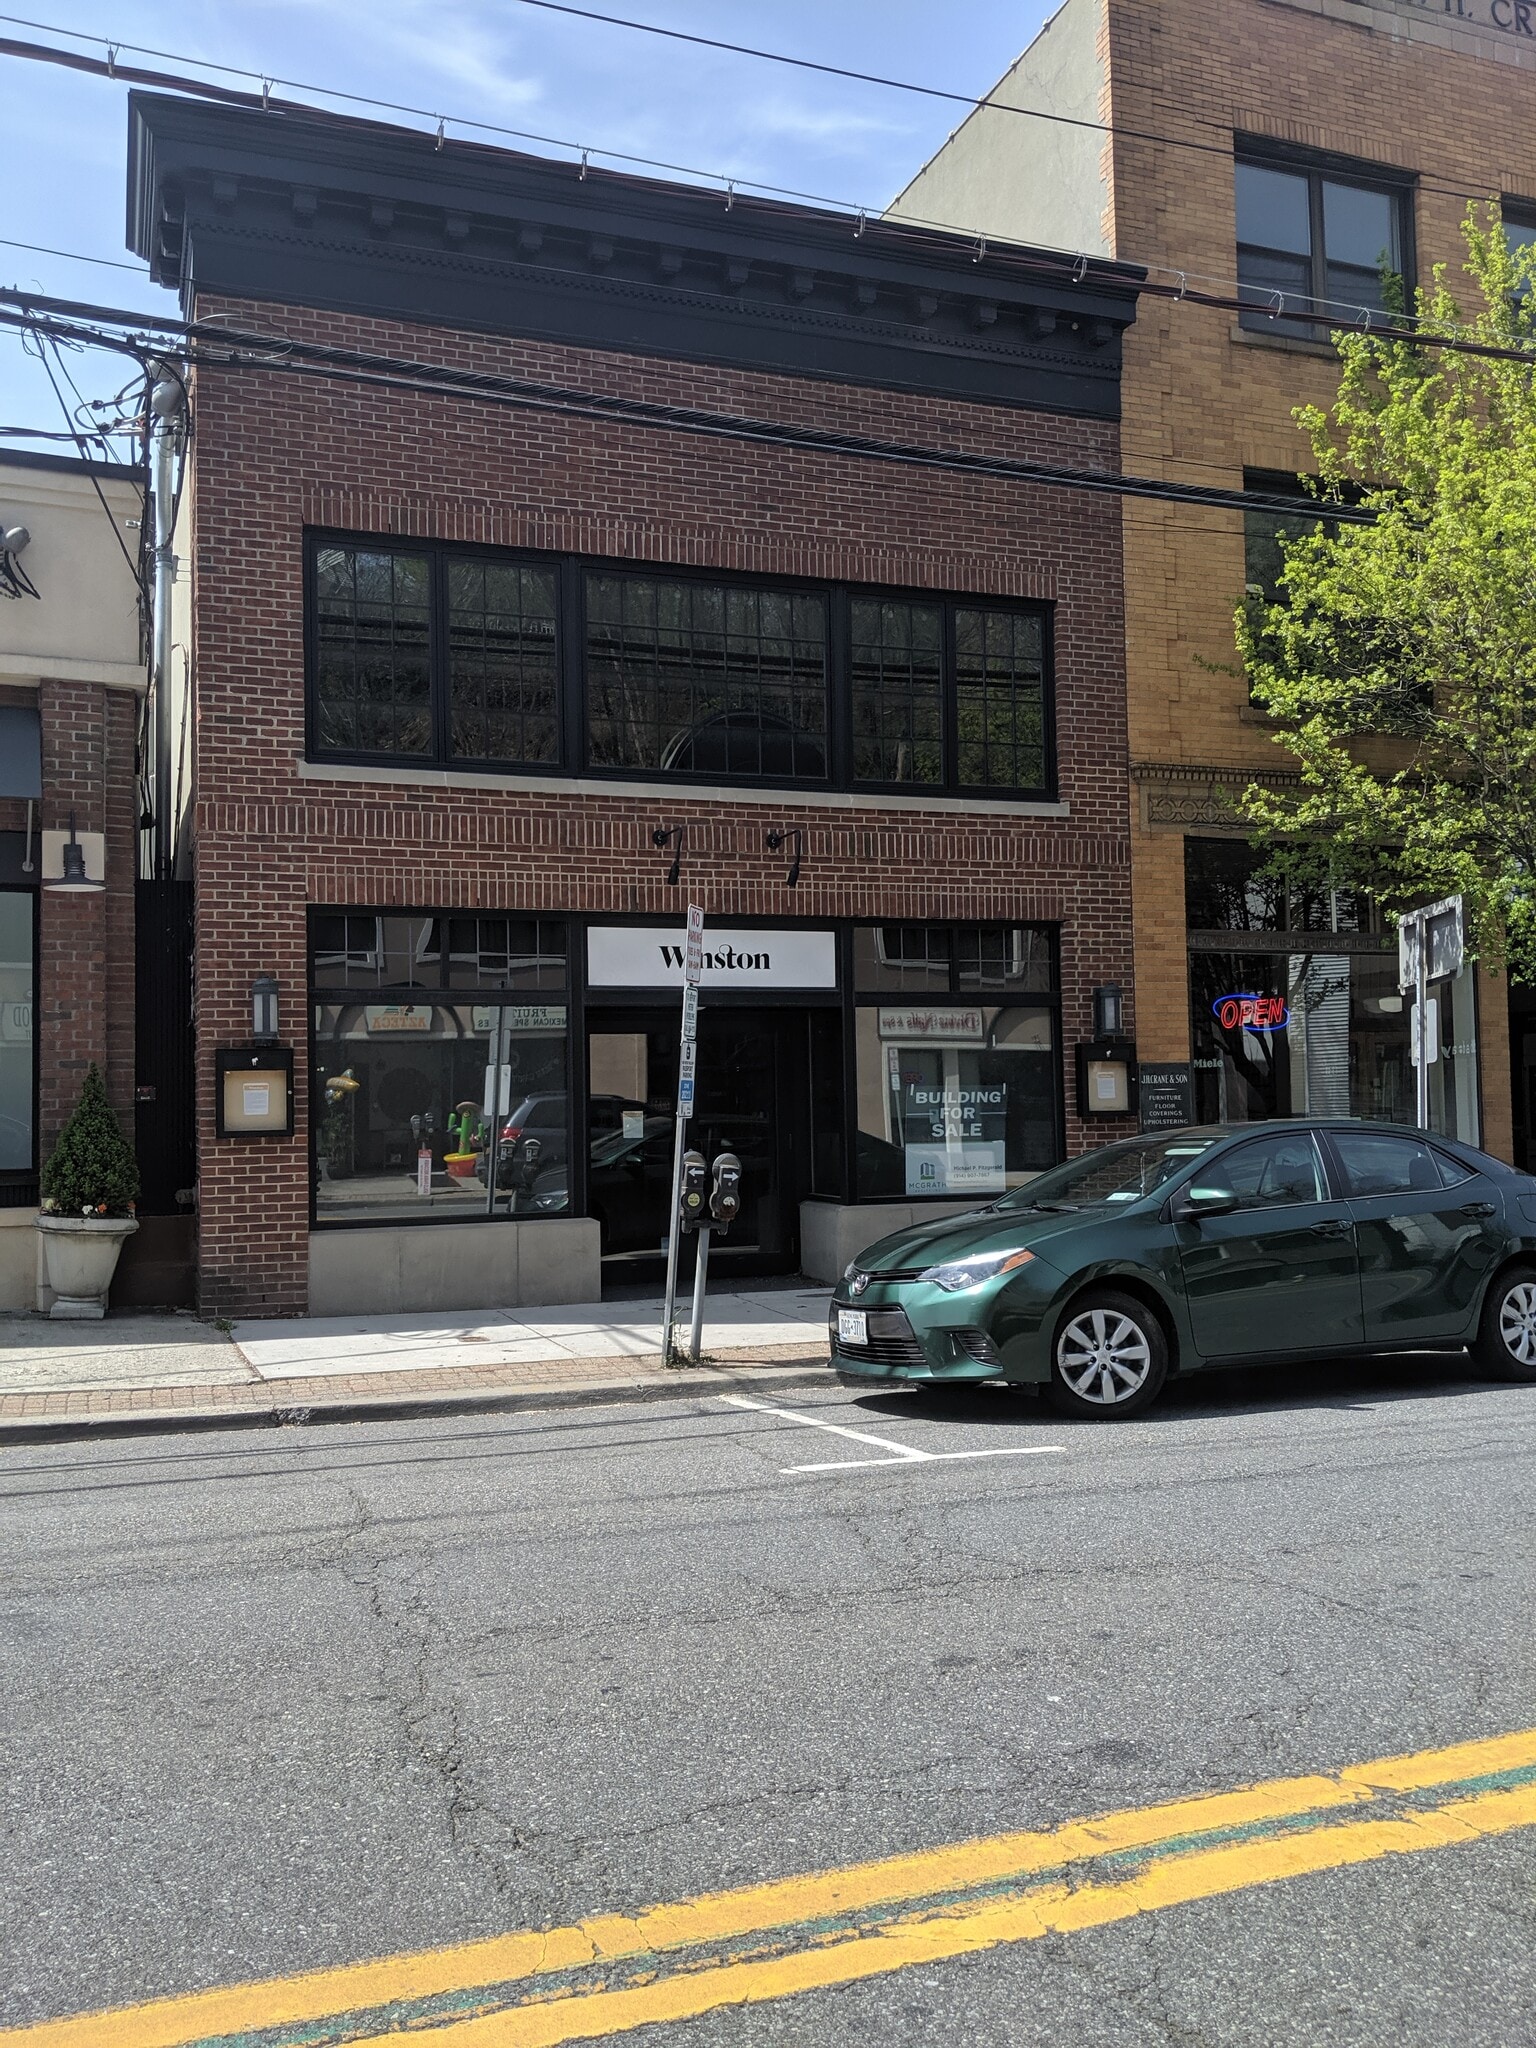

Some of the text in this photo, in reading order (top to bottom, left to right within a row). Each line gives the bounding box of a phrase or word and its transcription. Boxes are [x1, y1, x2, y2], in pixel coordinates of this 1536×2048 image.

[691, 911, 700, 928] NO
[658, 944, 771, 970] Wnston
[1221, 997, 1284, 1029] OPEN
[1193, 1058, 1224, 1069] Miele
[1169, 1075, 1175, 1084] &
[1175, 1074, 1188, 1084] SON
[915, 1091, 1001, 1104] BUILDING
[940, 1107, 976, 1119] FOR
[931, 1123, 982, 1137] SALE
[908, 1181, 947, 1190] MCGRATH
